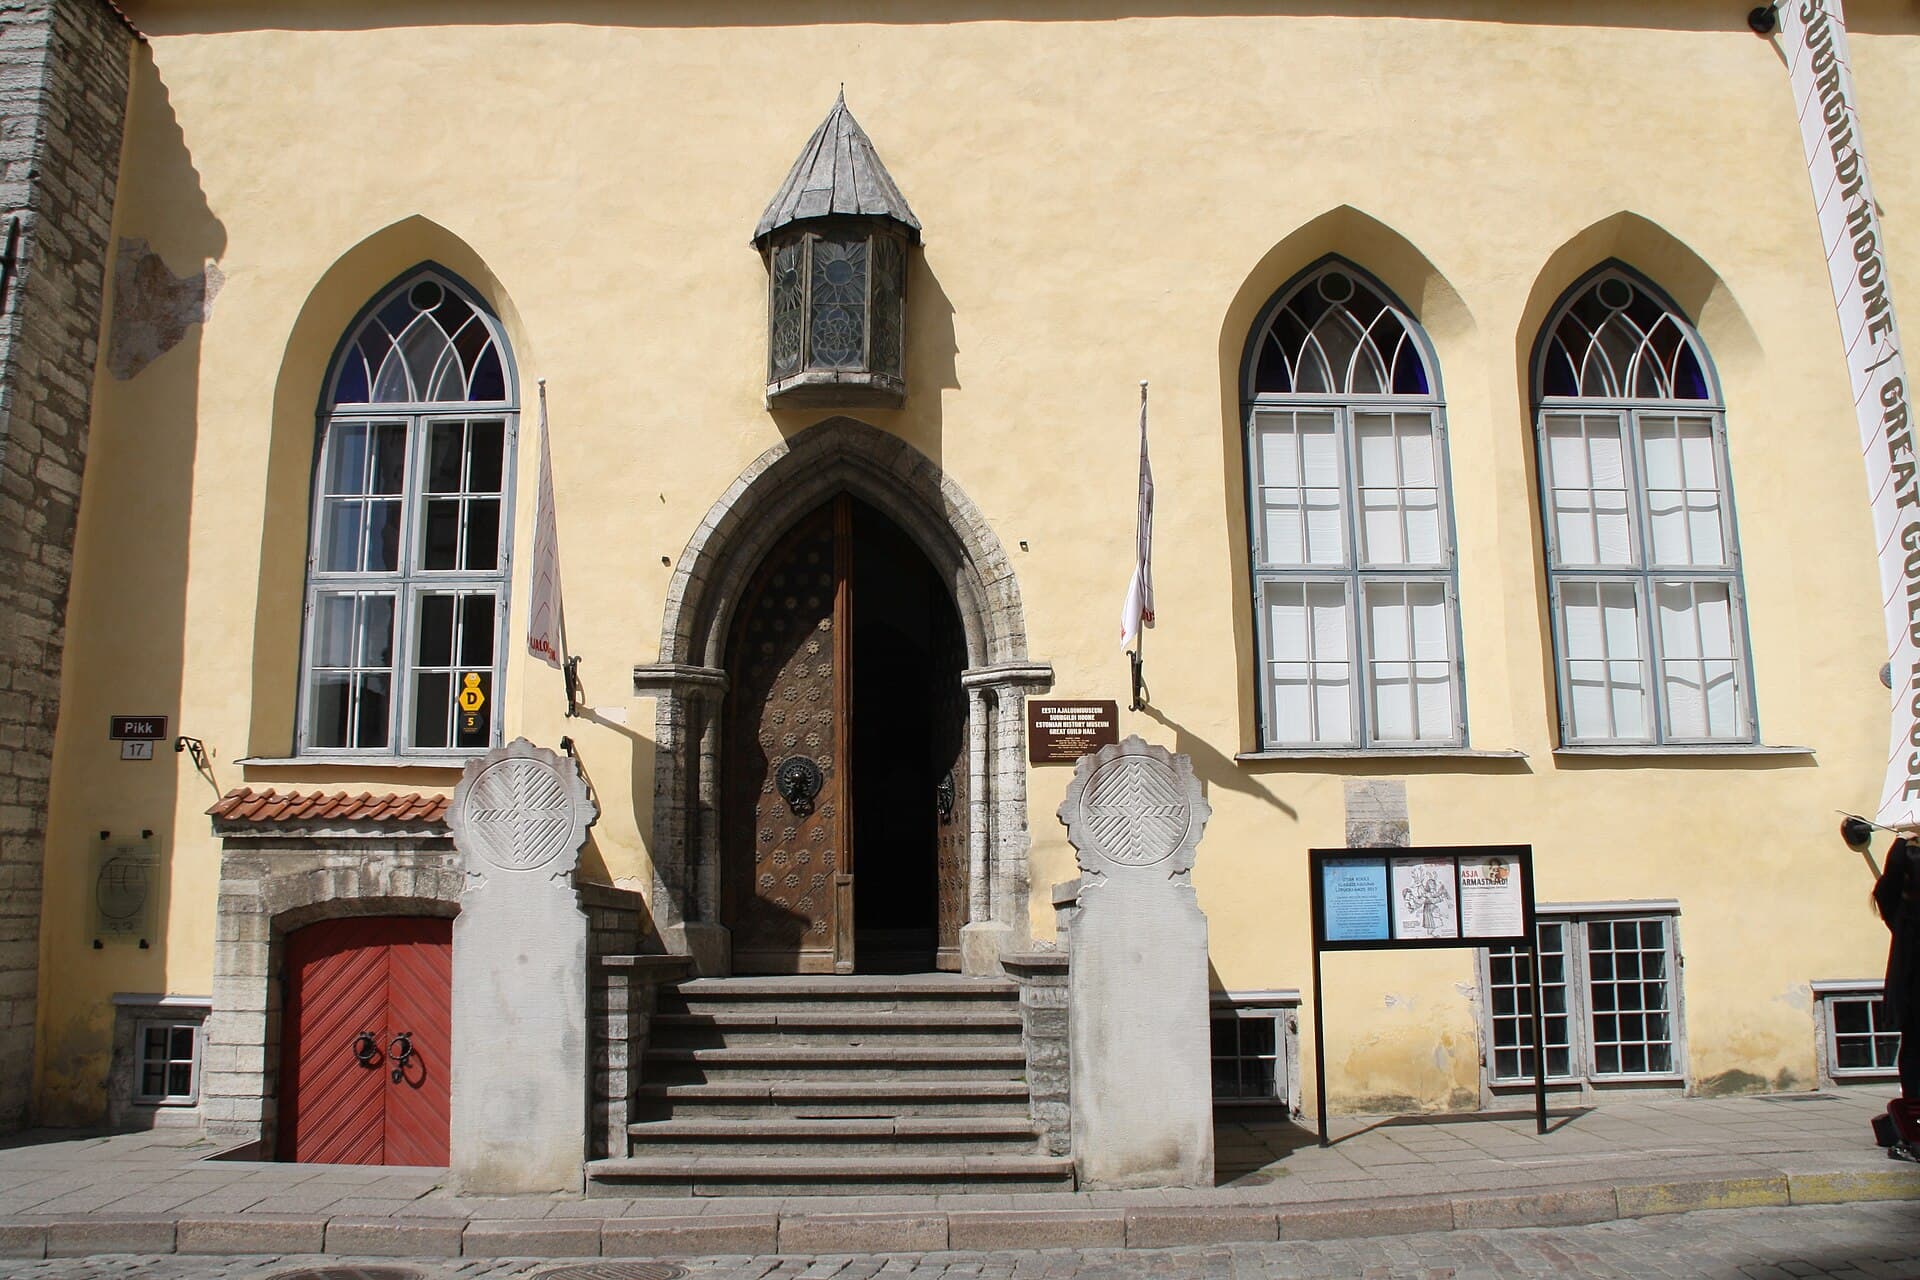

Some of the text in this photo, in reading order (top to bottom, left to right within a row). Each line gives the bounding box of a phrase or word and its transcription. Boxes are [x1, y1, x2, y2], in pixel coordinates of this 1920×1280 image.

[1846, 200, 1893, 345] HOONE
[1879, 376, 1920, 510] GREAT
[466, 692, 478, 704] D
[467, 717, 475, 726] 5
[124, 722, 153, 734] Pikk
[129, 743, 145, 756] 17
[1462, 870, 1479, 878] ASJA
